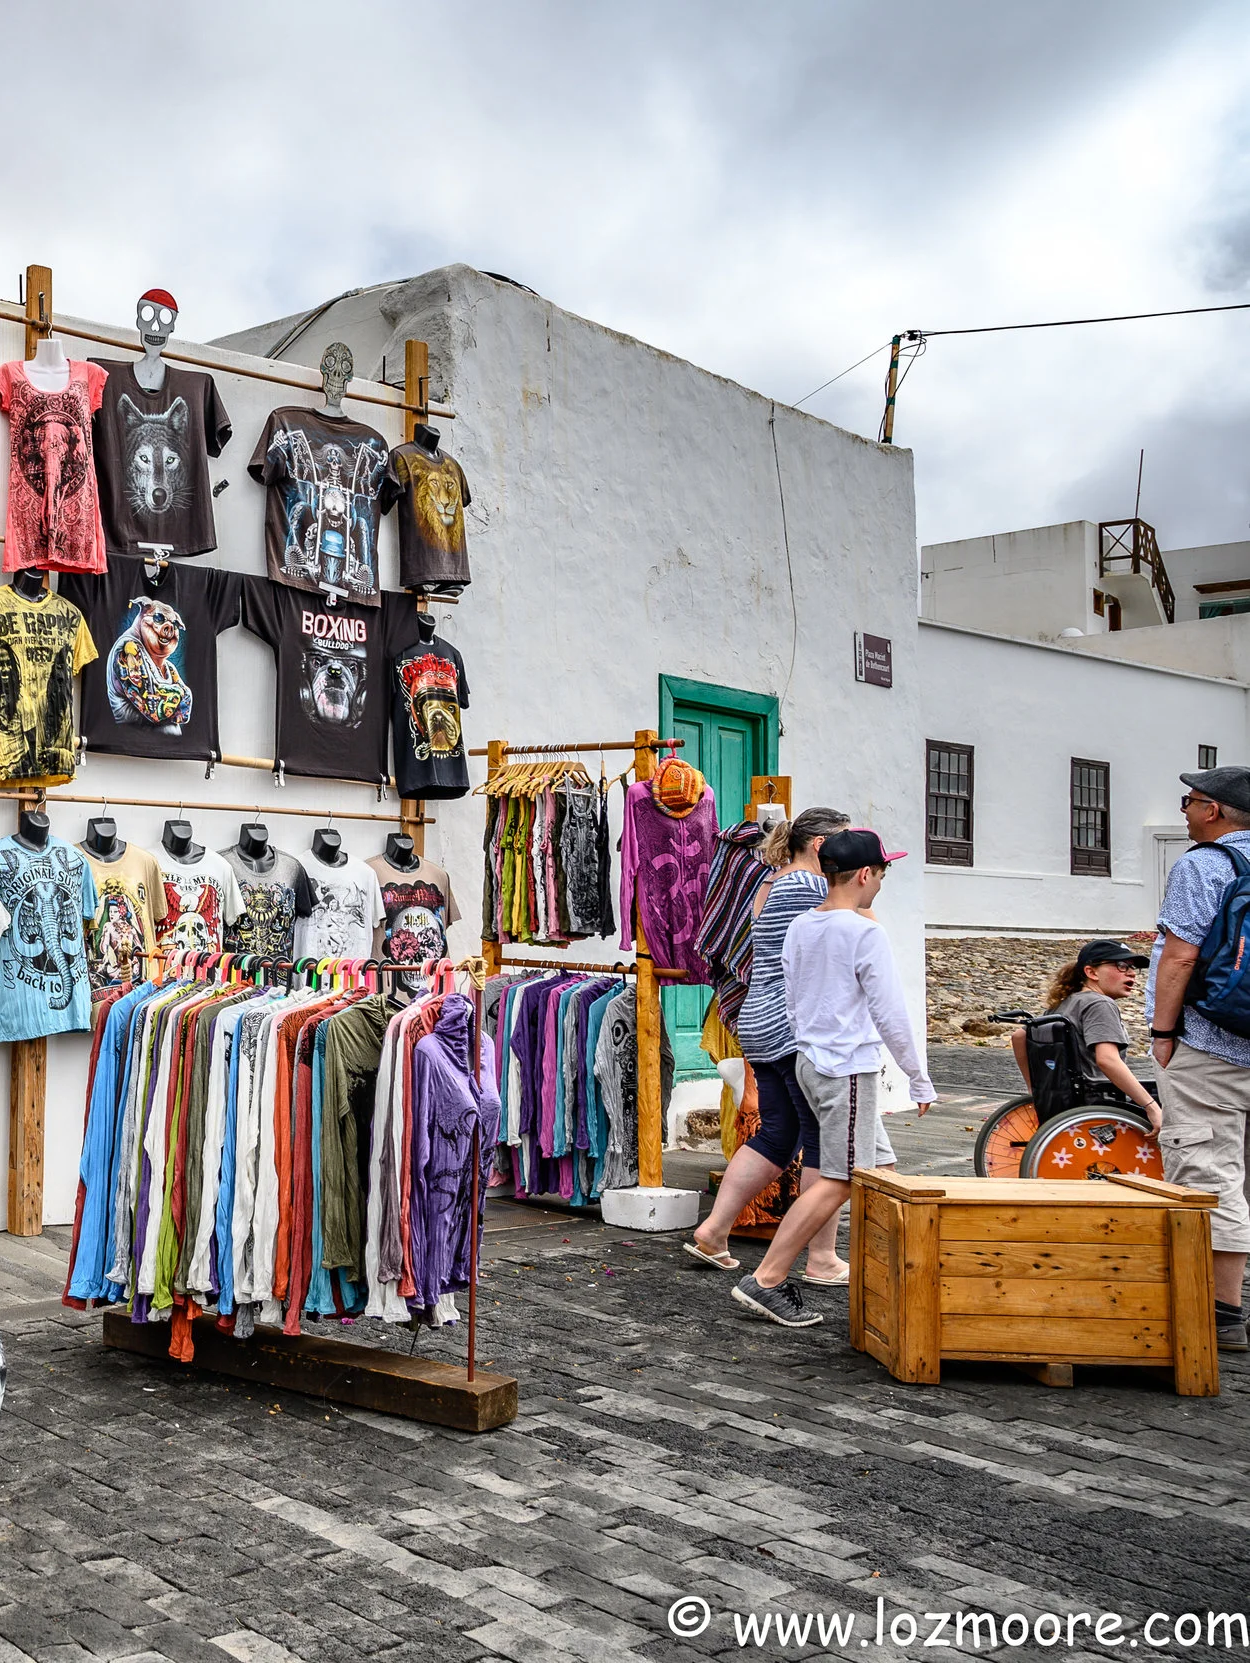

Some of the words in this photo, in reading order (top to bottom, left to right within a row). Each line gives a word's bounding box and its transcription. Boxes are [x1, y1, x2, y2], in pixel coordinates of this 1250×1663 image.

[22, 611, 69, 637] HAPP
[301, 610, 367, 642] BOXING
[317, 638, 349, 651] BULLDOG
[6, 867, 55, 899] ORIGINAL
[192, 876, 206, 885] MY
[16, 964, 47, 991] back
[50, 981, 62, 993] to
